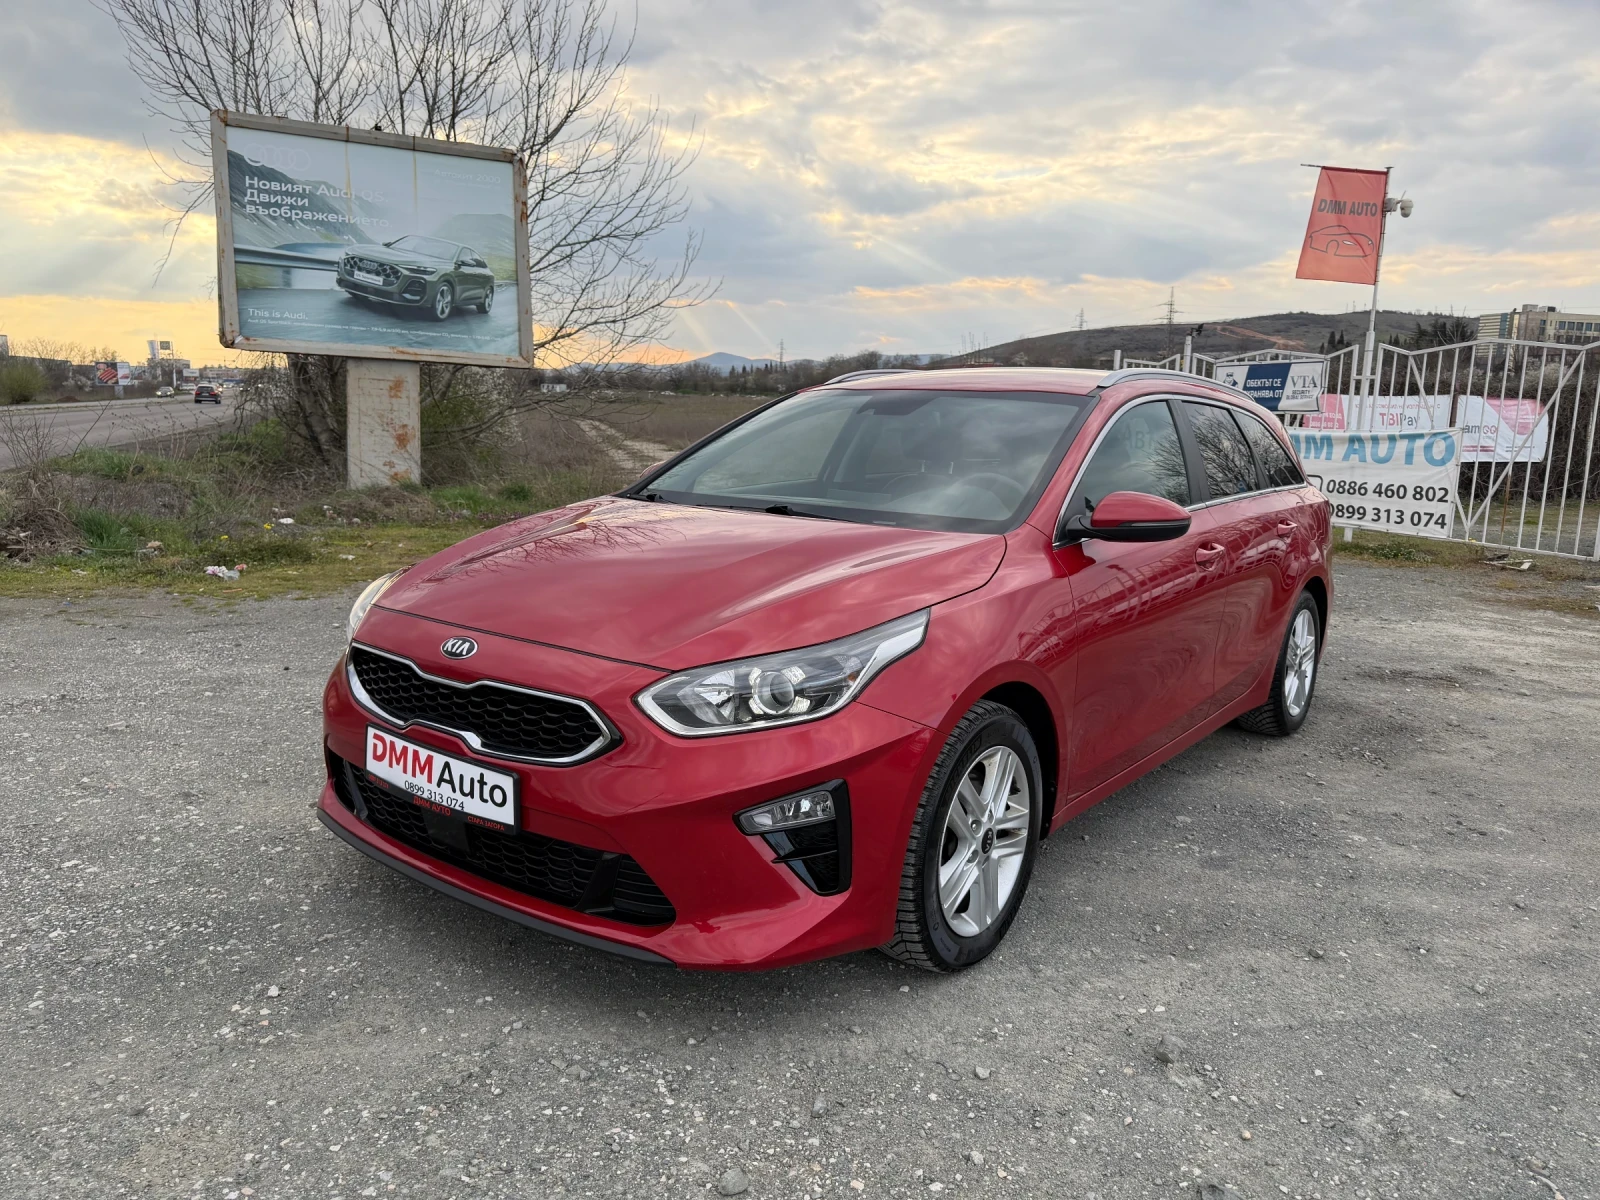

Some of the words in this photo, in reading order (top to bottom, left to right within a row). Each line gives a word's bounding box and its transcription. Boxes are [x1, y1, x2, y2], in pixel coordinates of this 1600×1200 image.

[244, 175, 312, 194] Новият
[316, 182, 354, 199] Audi
[244, 190, 309, 207] Движи
[1317, 198, 1346, 215] DMM
[1348, 201, 1378, 217] AUTO
[245, 205, 393, 229] въображението.
[248, 308, 269, 318] This
[272, 309, 281, 319] is
[283, 309, 309, 320] Audi.
[1246, 378, 1272, 387] ОБЕКТЪТ
[1273, 378, 1282, 387] СЕ
[1290, 375, 1318, 388] VTA
[1245, 389, 1273, 399] ХРАНЯВА
[1274, 389, 1284, 398] ОТ
[1341, 432, 1455, 467] AUTO
[1326, 479, 1368, 497] 0886
[1372, 482, 1407, 500] 460
[1412, 486, 1449, 503] 802
[1371, 507, 1405, 525] 313
[1409, 511, 1447, 529] 074
[444, 638, 470, 656] KIA
[404, 780, 425, 796] 0899
[427, 789, 444, 804] 313
[446, 796, 465, 811] 074
[467, 815, 484, 825] СТАРА
[485, 820, 505, 831] ЗАГОРА
